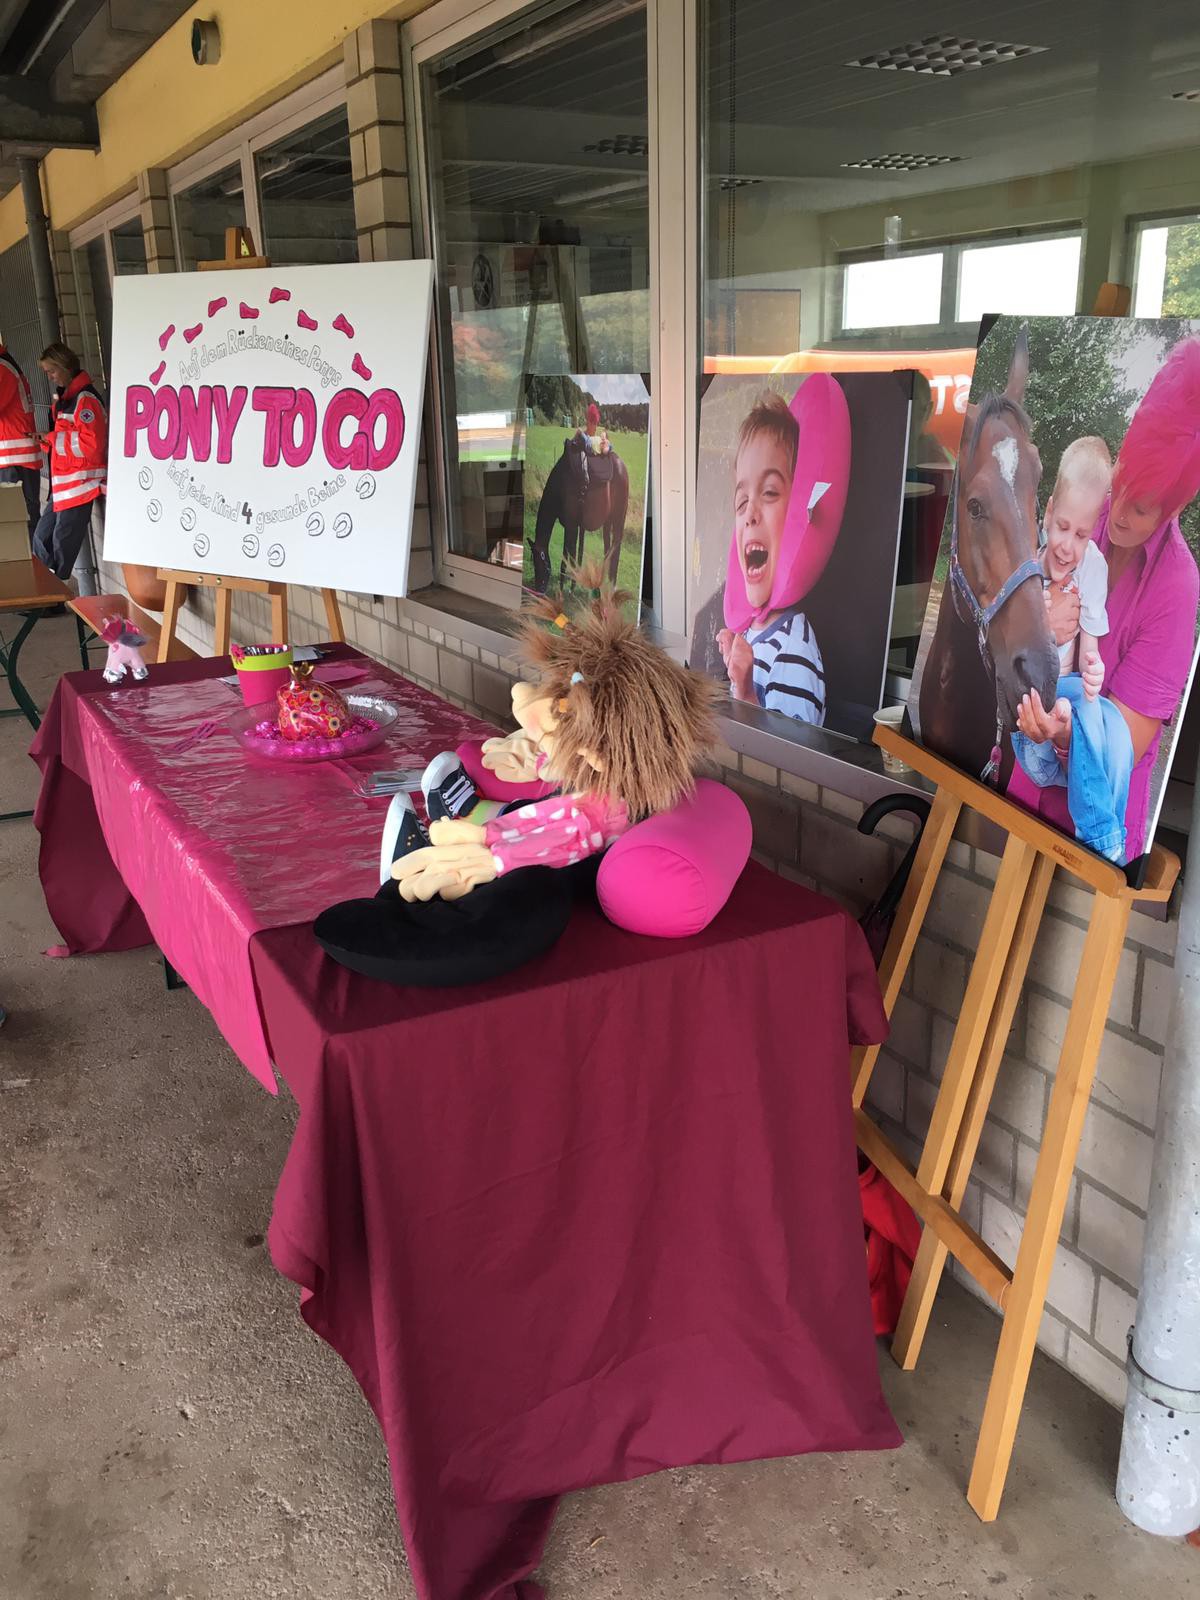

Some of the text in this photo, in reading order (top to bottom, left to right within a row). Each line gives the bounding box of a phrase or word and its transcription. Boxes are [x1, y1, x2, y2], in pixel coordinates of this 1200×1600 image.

[178, 347, 201, 384] Auf
[200, 345, 228, 368] dem
[306, 345, 343, 388] Ponys
[124, 384, 405, 471] PONY TO GO
[166, 460, 347, 534] hat jedes Kind 4 gesunde Beine
